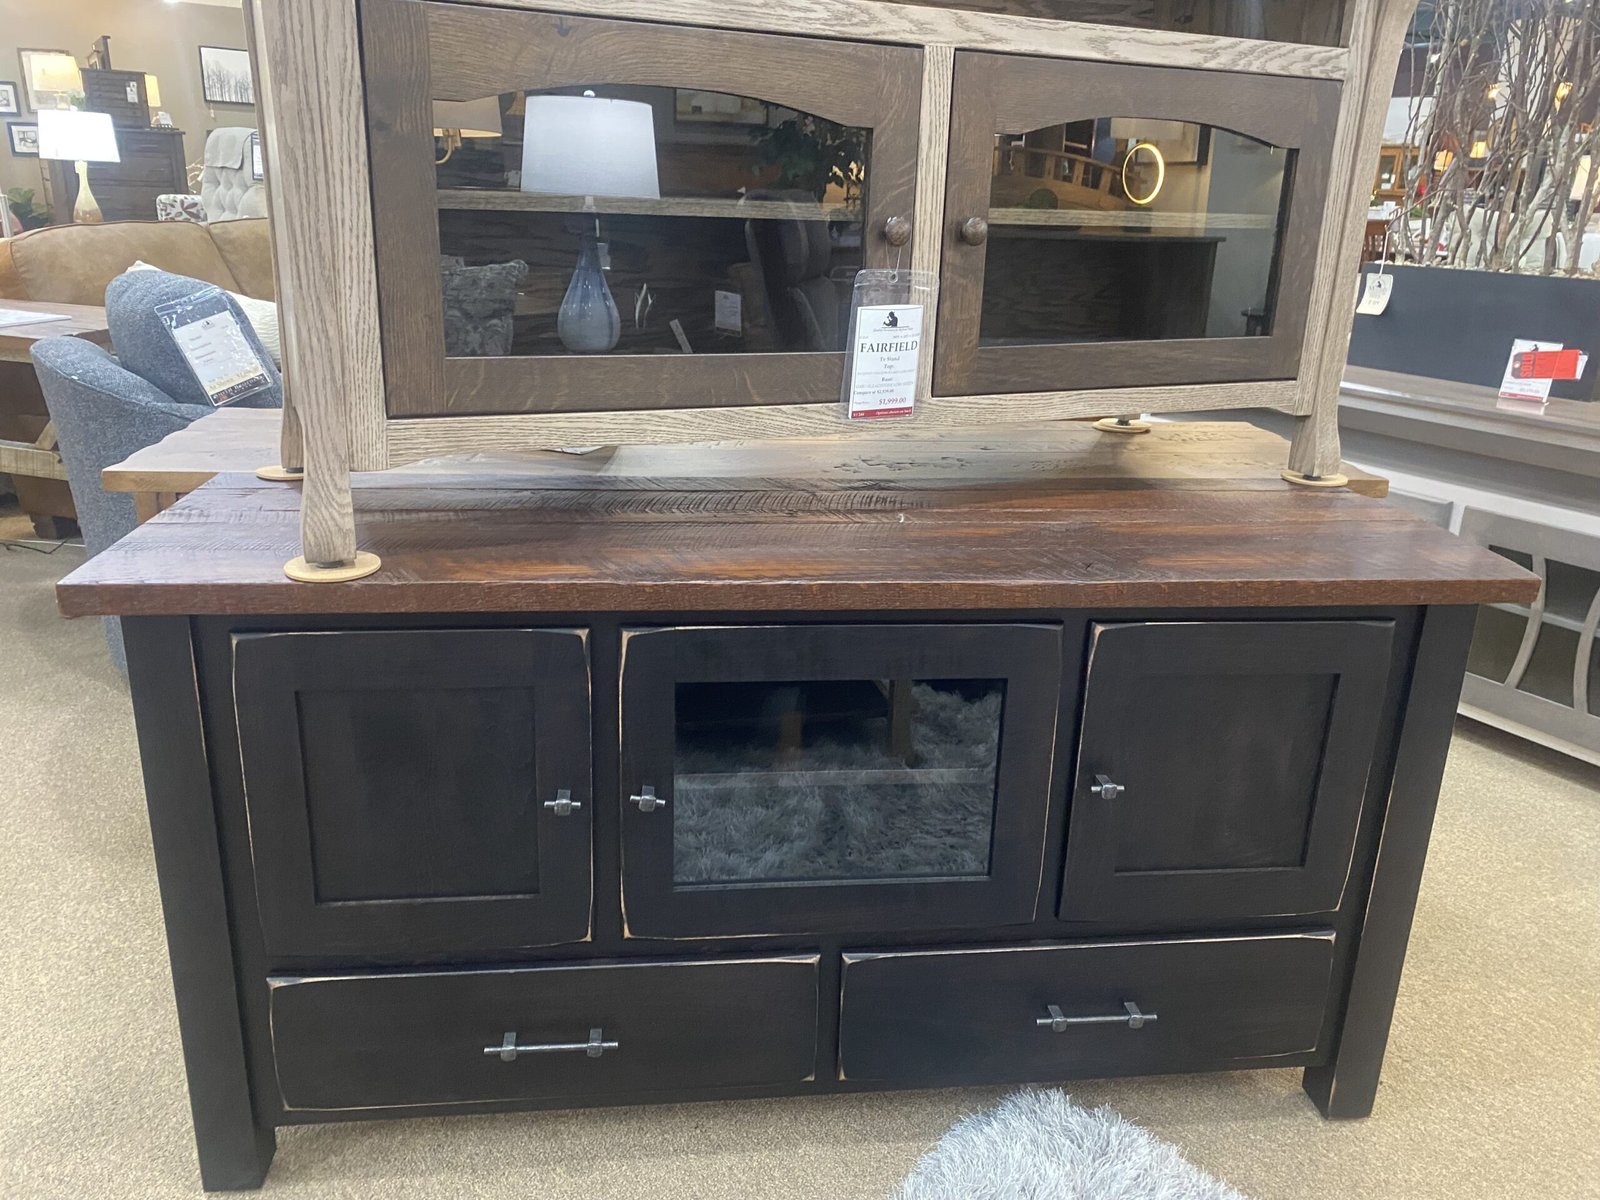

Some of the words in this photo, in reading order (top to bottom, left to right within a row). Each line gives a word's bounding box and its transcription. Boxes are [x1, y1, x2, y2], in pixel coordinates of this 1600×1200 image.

[860, 340, 918, 353] FAIRFIELD
[1520, 353, 1533, 378] SOLD
[878, 396, 907, 406] $1,999.00
